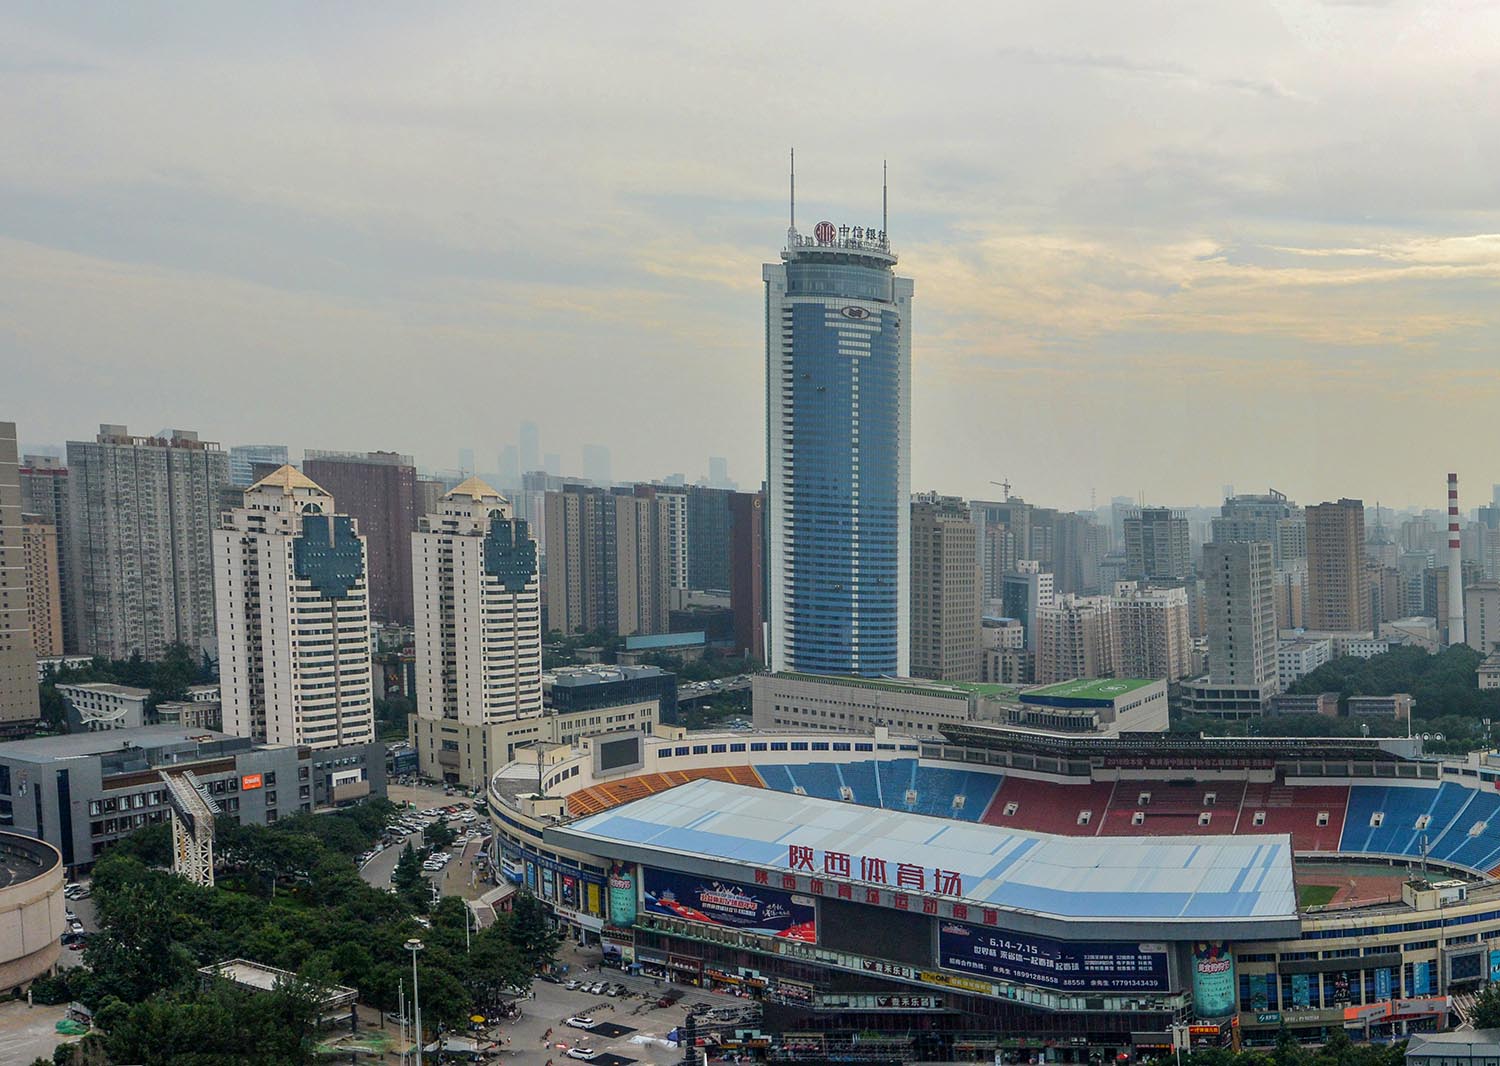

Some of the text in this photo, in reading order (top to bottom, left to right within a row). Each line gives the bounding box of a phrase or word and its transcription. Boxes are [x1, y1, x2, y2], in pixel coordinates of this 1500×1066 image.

[789, 845, 962, 896] 陕西体育场
[755, 870, 998, 925] 陕西体育场运动商城
[989, 938, 1038, 954] 6.14-7.15
